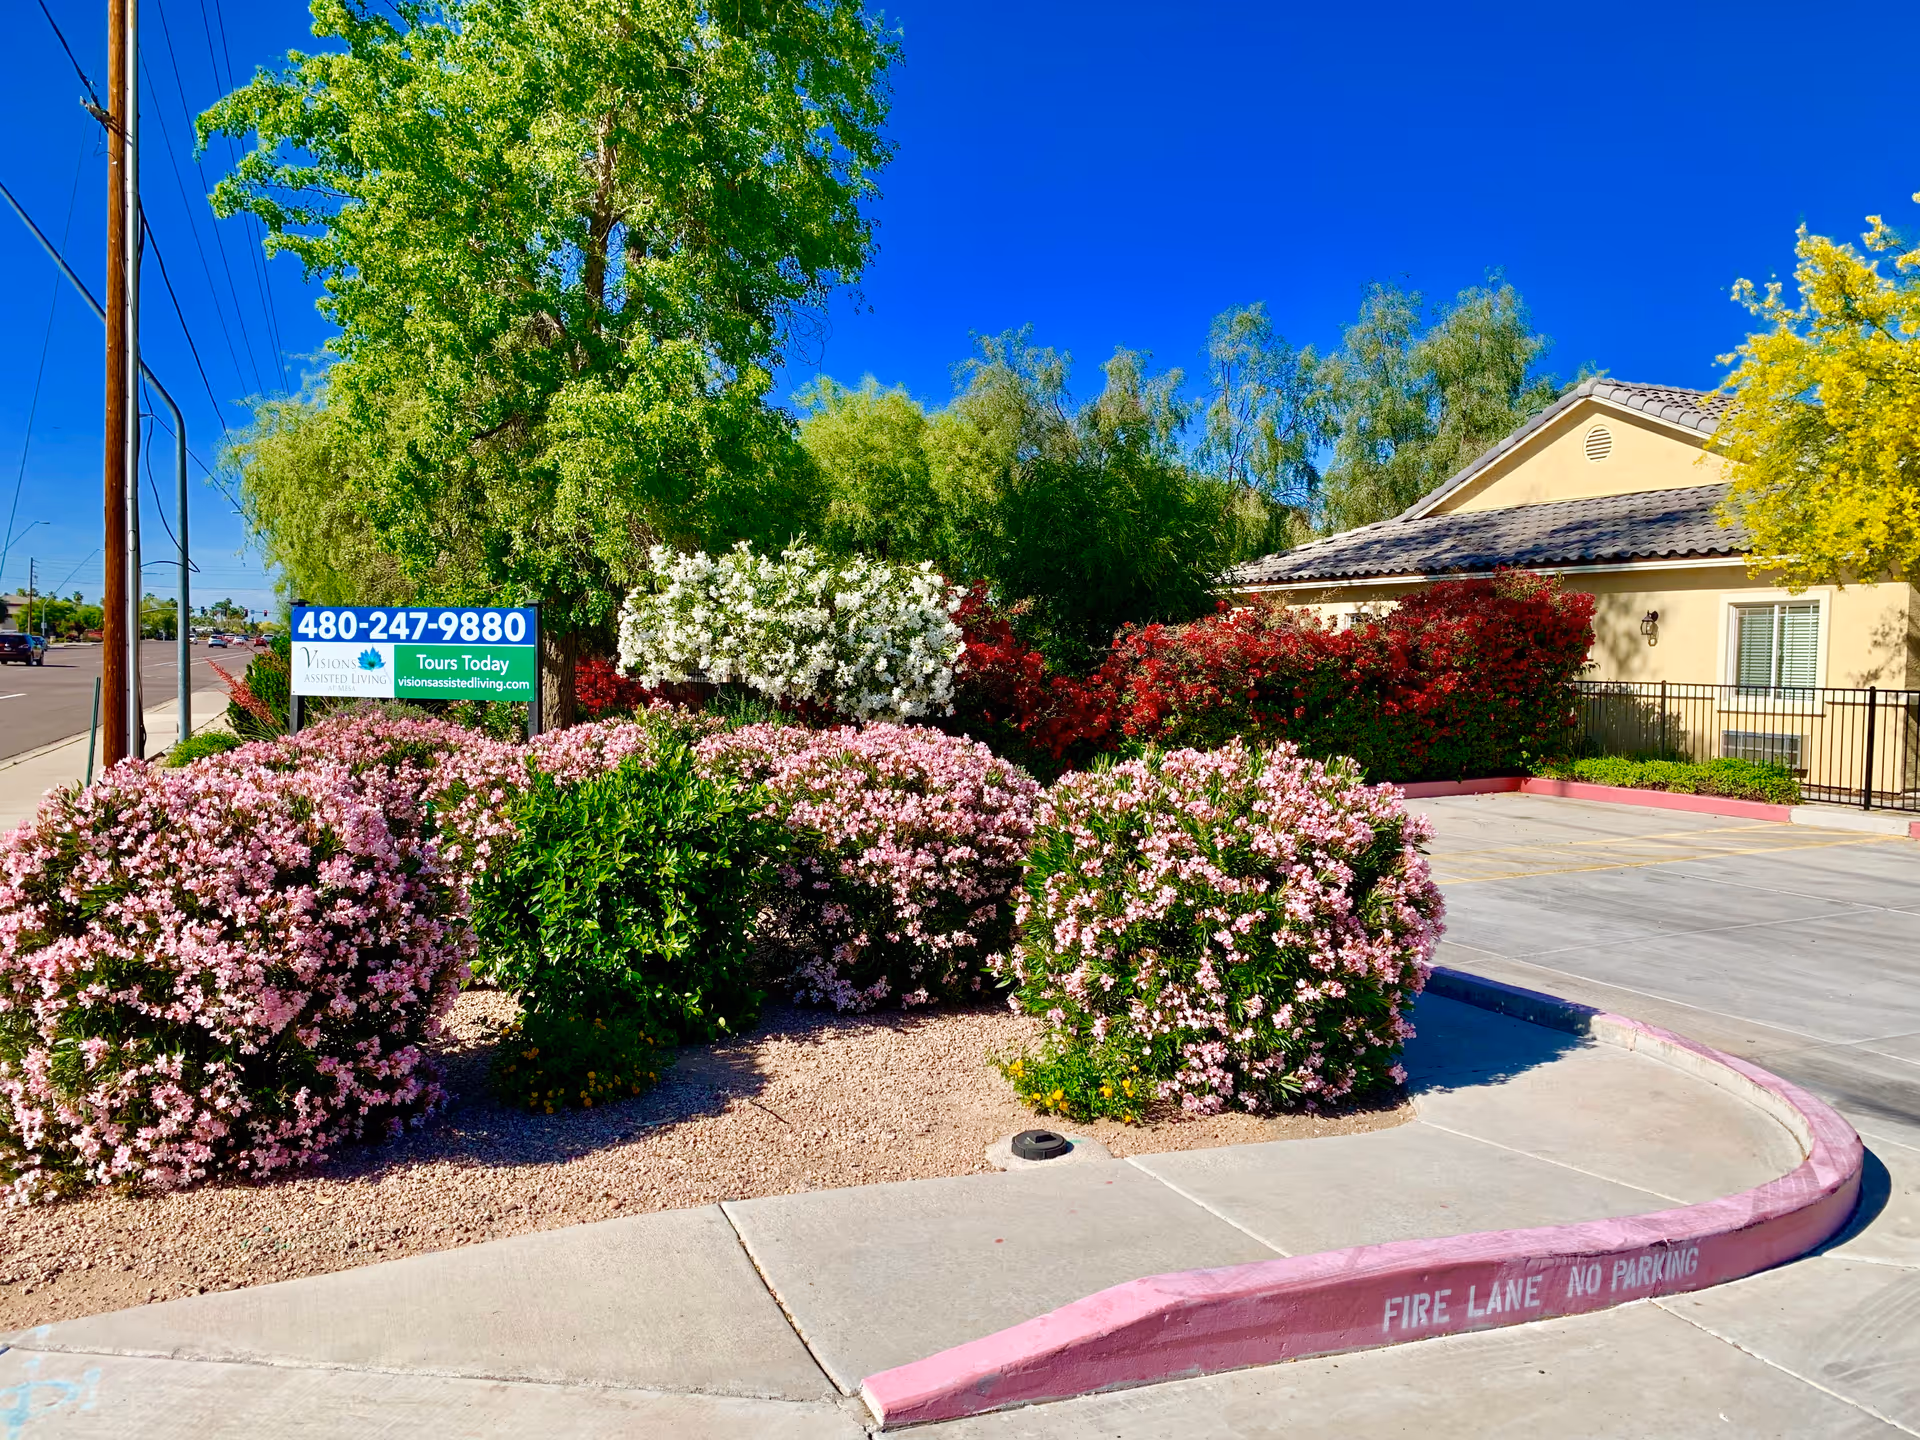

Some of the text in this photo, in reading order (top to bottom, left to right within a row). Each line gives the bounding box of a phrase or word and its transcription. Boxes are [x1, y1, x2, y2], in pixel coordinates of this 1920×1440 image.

[298, 611, 526, 642] 480-247-9880
[300, 646, 357, 669] VISIONS
[416, 654, 509, 675] Tours Today
[304, 672, 387, 685] ASSISTED LIVING
[398, 676, 530, 692] visionsassistedliving.com
[1382, 1247, 1699, 1333] FIRE LANE NO PARKING
